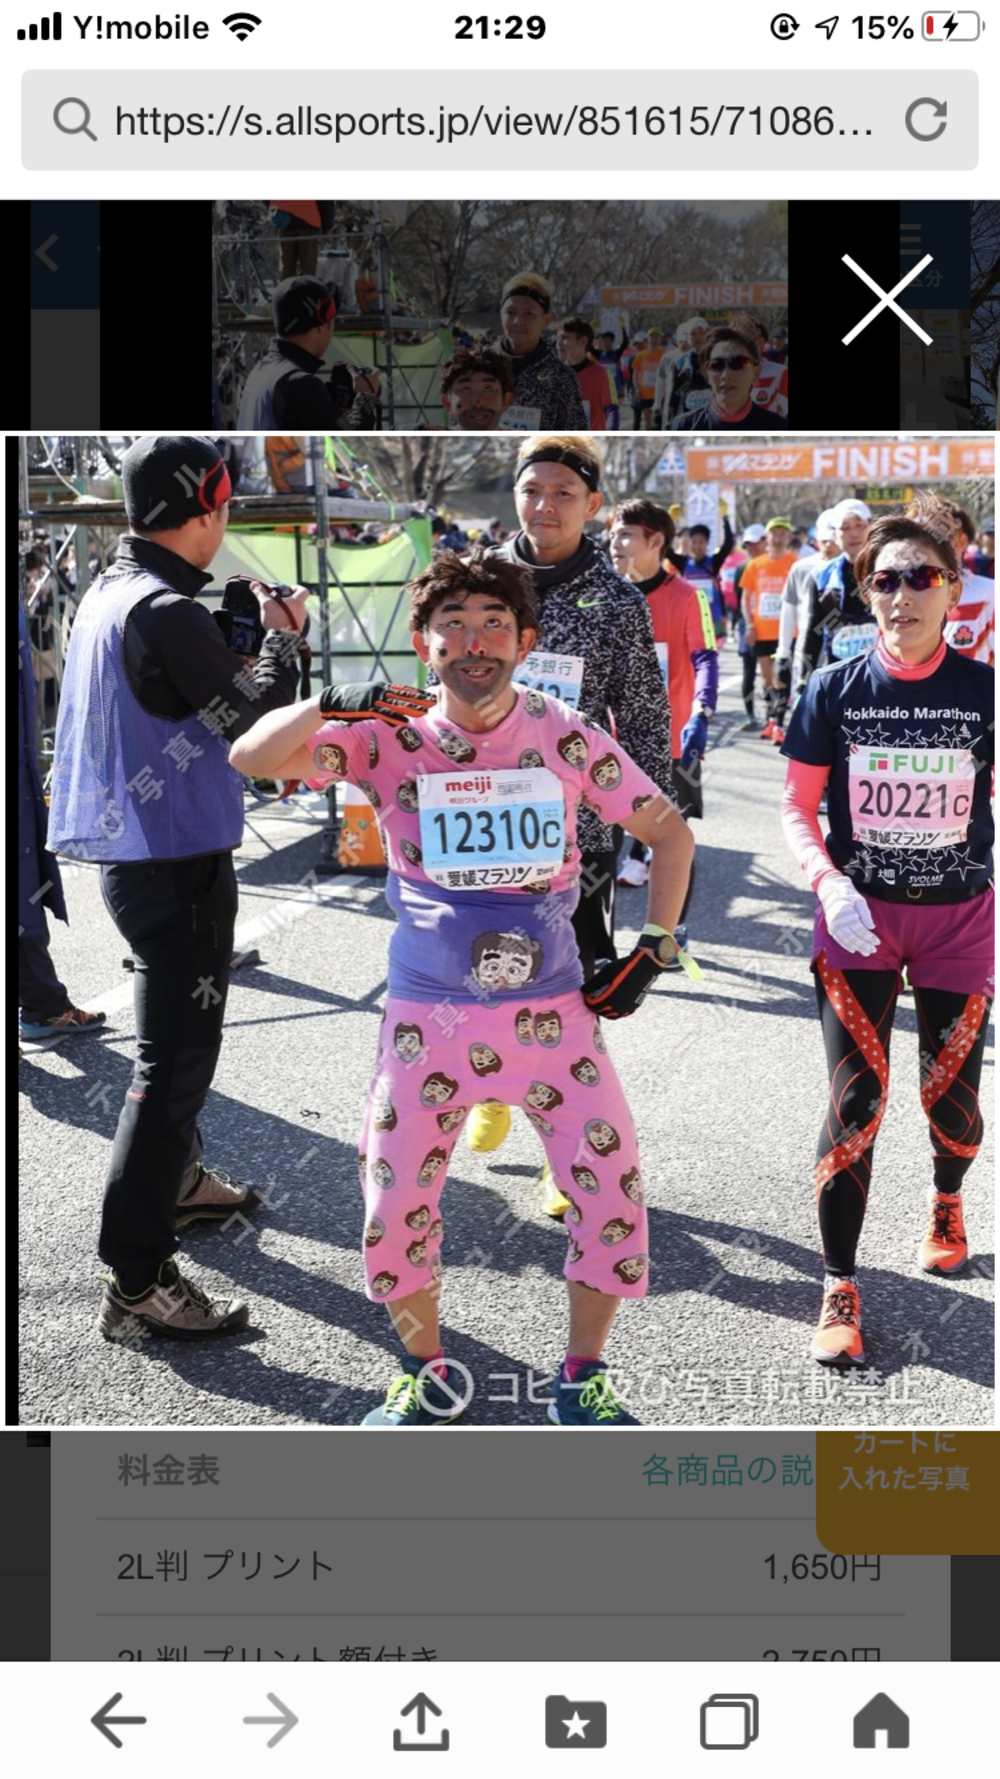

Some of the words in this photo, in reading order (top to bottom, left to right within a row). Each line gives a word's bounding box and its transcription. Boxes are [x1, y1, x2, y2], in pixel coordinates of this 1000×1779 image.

[73, 14, 210, 40] Y!mobile
[454, 14, 546, 41] 21:29
[851, 15, 915, 40] 15%
[674, 284, 755, 306] FINISH
[812, 444, 948, 478] FINISH
[844, 706, 909, 720] Hokkaido
[913, 707, 981, 722] Marathon
[893, 754, 954, 774] FUJI
[445, 776, 492, 794] meiji
[868, 829, 941, 846] 愛媛マラソン
[447, 866, 533, 887] 愛媛マラソン
[854, 1431, 957, 1454] カートに
[117, 1453, 220, 1487] 料金表
[642, 1453, 814, 1487] 各商品の説
[838, 1465, 970, 1492] 入れた写真
[117, 1549, 187, 1582] 2L判
[203, 1549, 332, 1582] プリント
[764, 1553, 881, 1585] 1,650円
